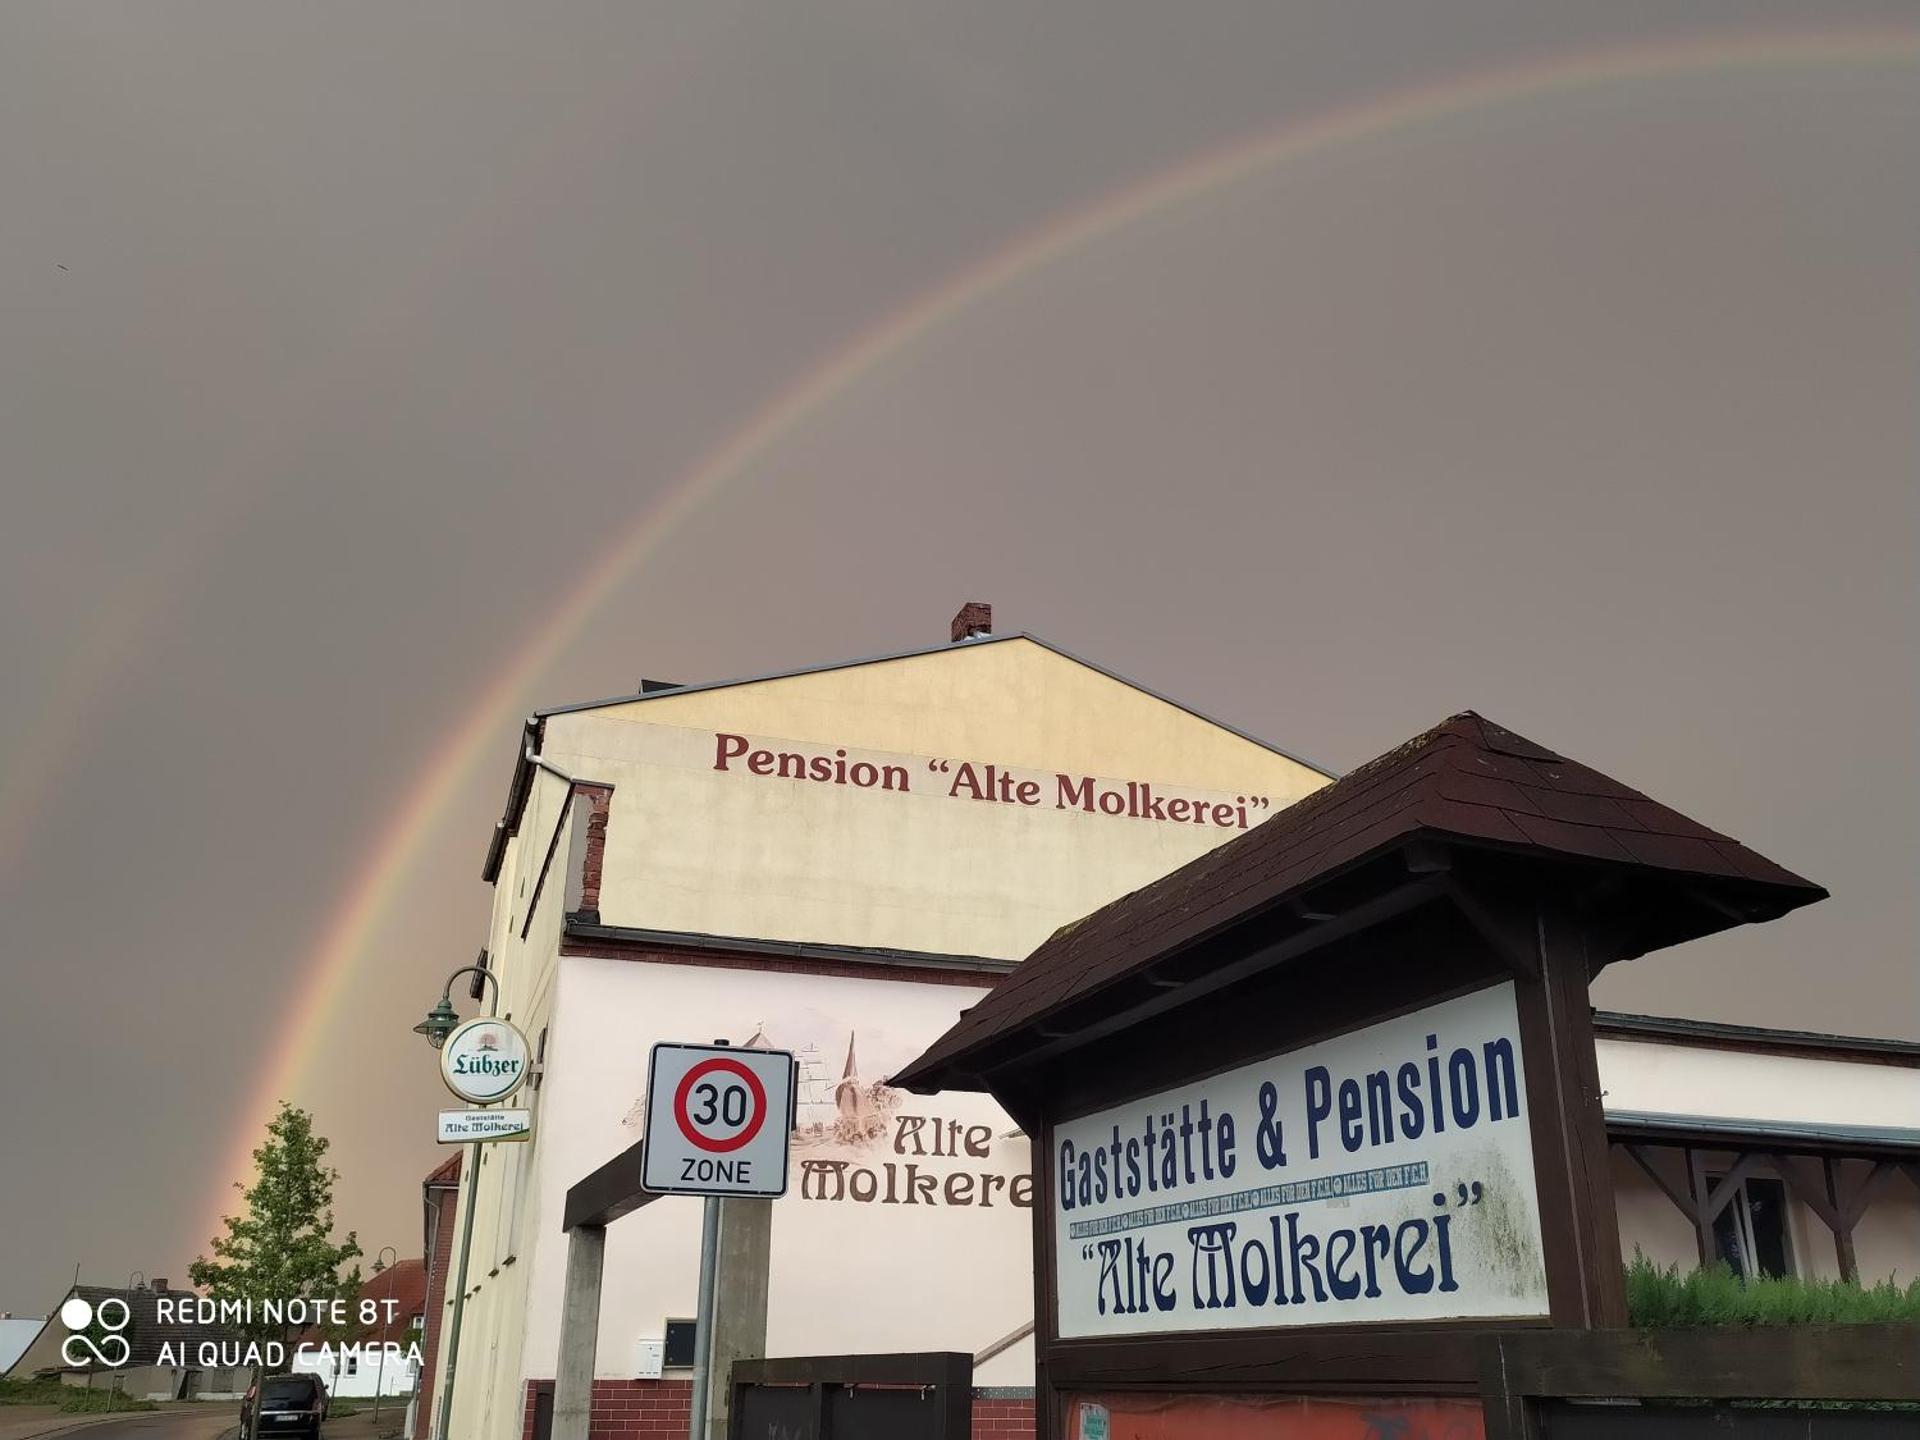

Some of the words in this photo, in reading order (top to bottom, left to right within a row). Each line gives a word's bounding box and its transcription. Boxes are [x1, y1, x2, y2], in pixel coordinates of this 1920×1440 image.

[714, 733, 910, 792] Pension
[929, 758, 1041, 806] “Alte
[1055, 773, 1269, 828] Molkerei”
[453, 1054, 519, 1077] Lübzer
[694, 1083, 747, 1127] 30
[1060, 1099, 1236, 1211] Gaststätte
[1256, 1081, 1287, 1170] &
[1305, 1034, 1519, 1160] Pension
[444, 1123, 469, 1132] Alte
[894, 1115, 993, 1158] Alte
[681, 1158, 752, 1184] ZONE
[800, 1160, 1033, 1208] Molkere
[1082, 1237, 1177, 1316] “Alte
[1188, 1180, 1482, 1310] Molkerei”
